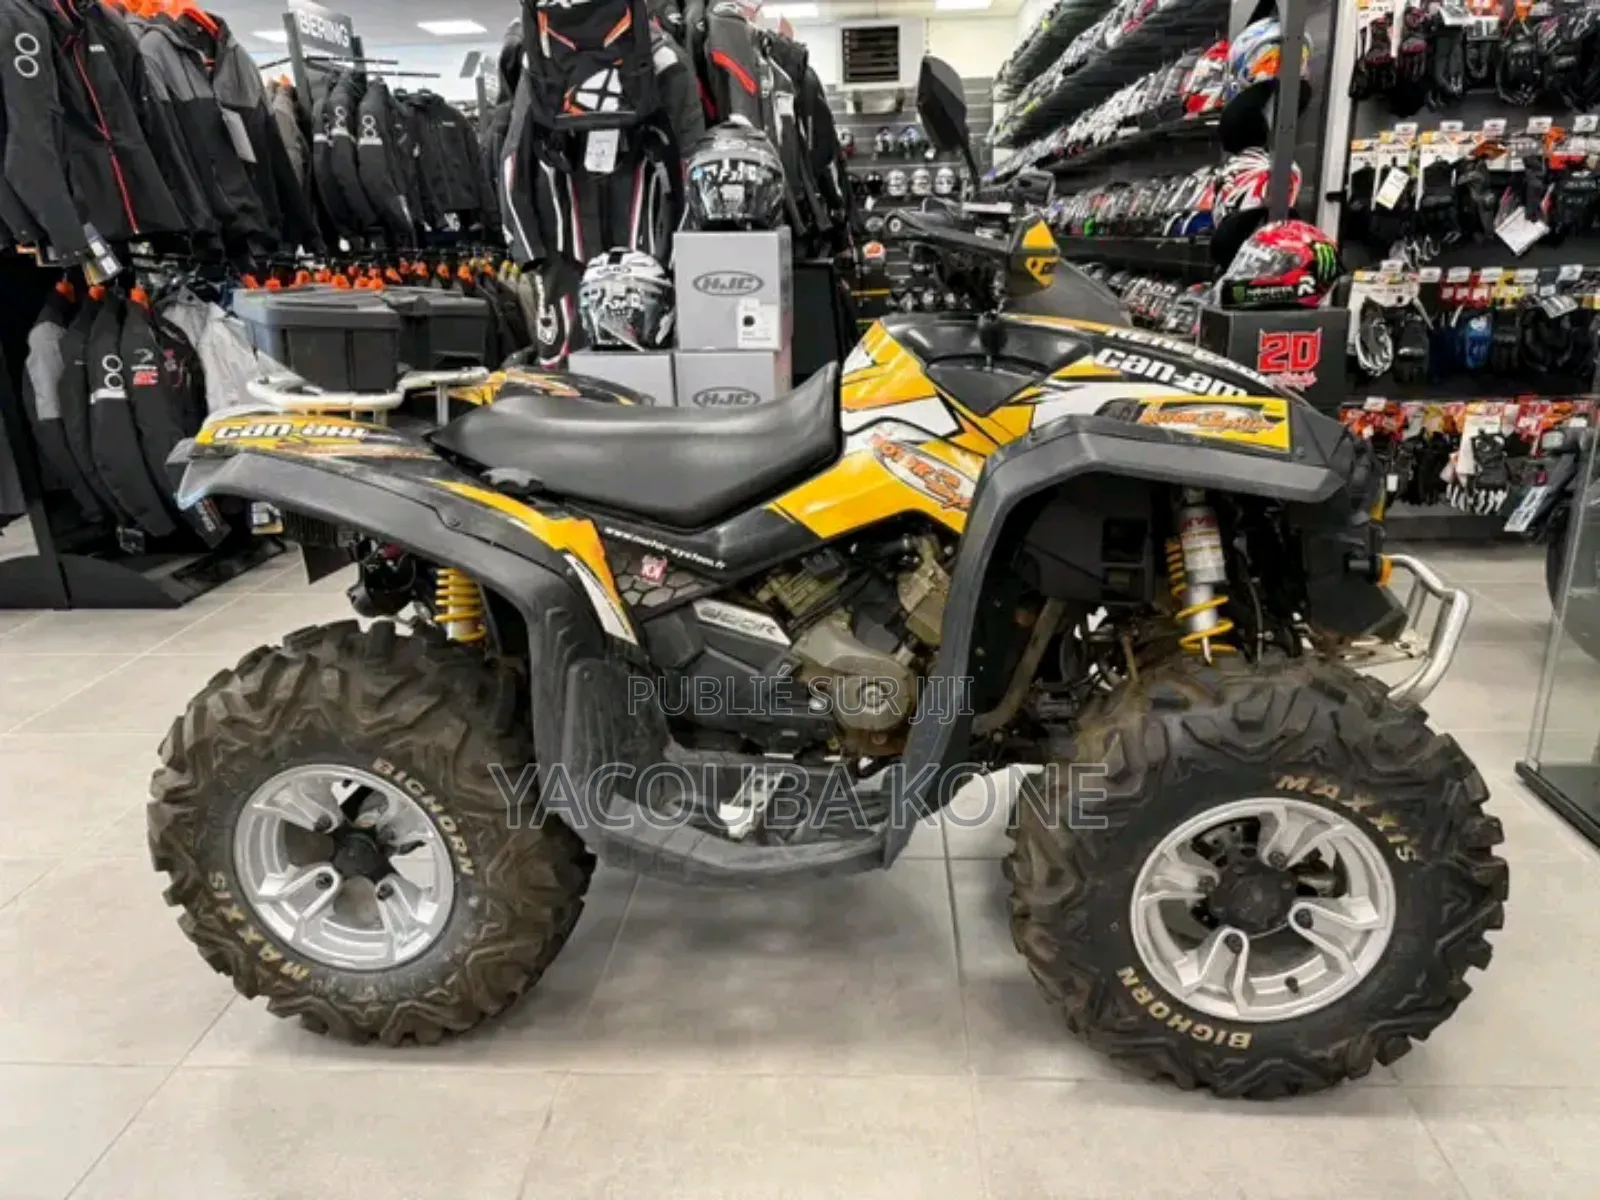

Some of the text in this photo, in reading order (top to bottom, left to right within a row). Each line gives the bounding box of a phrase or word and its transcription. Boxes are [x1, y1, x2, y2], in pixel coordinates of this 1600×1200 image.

[701, 277, 754, 290] HJC
[1095, 348, 1247, 396] can-am
[374, 758, 474, 875] BIGHORN
[1276, 774, 1417, 863] MAXXIS
[209, 873, 310, 979] MAXXIS
[1117, 965, 1252, 1049] BIGHORN
